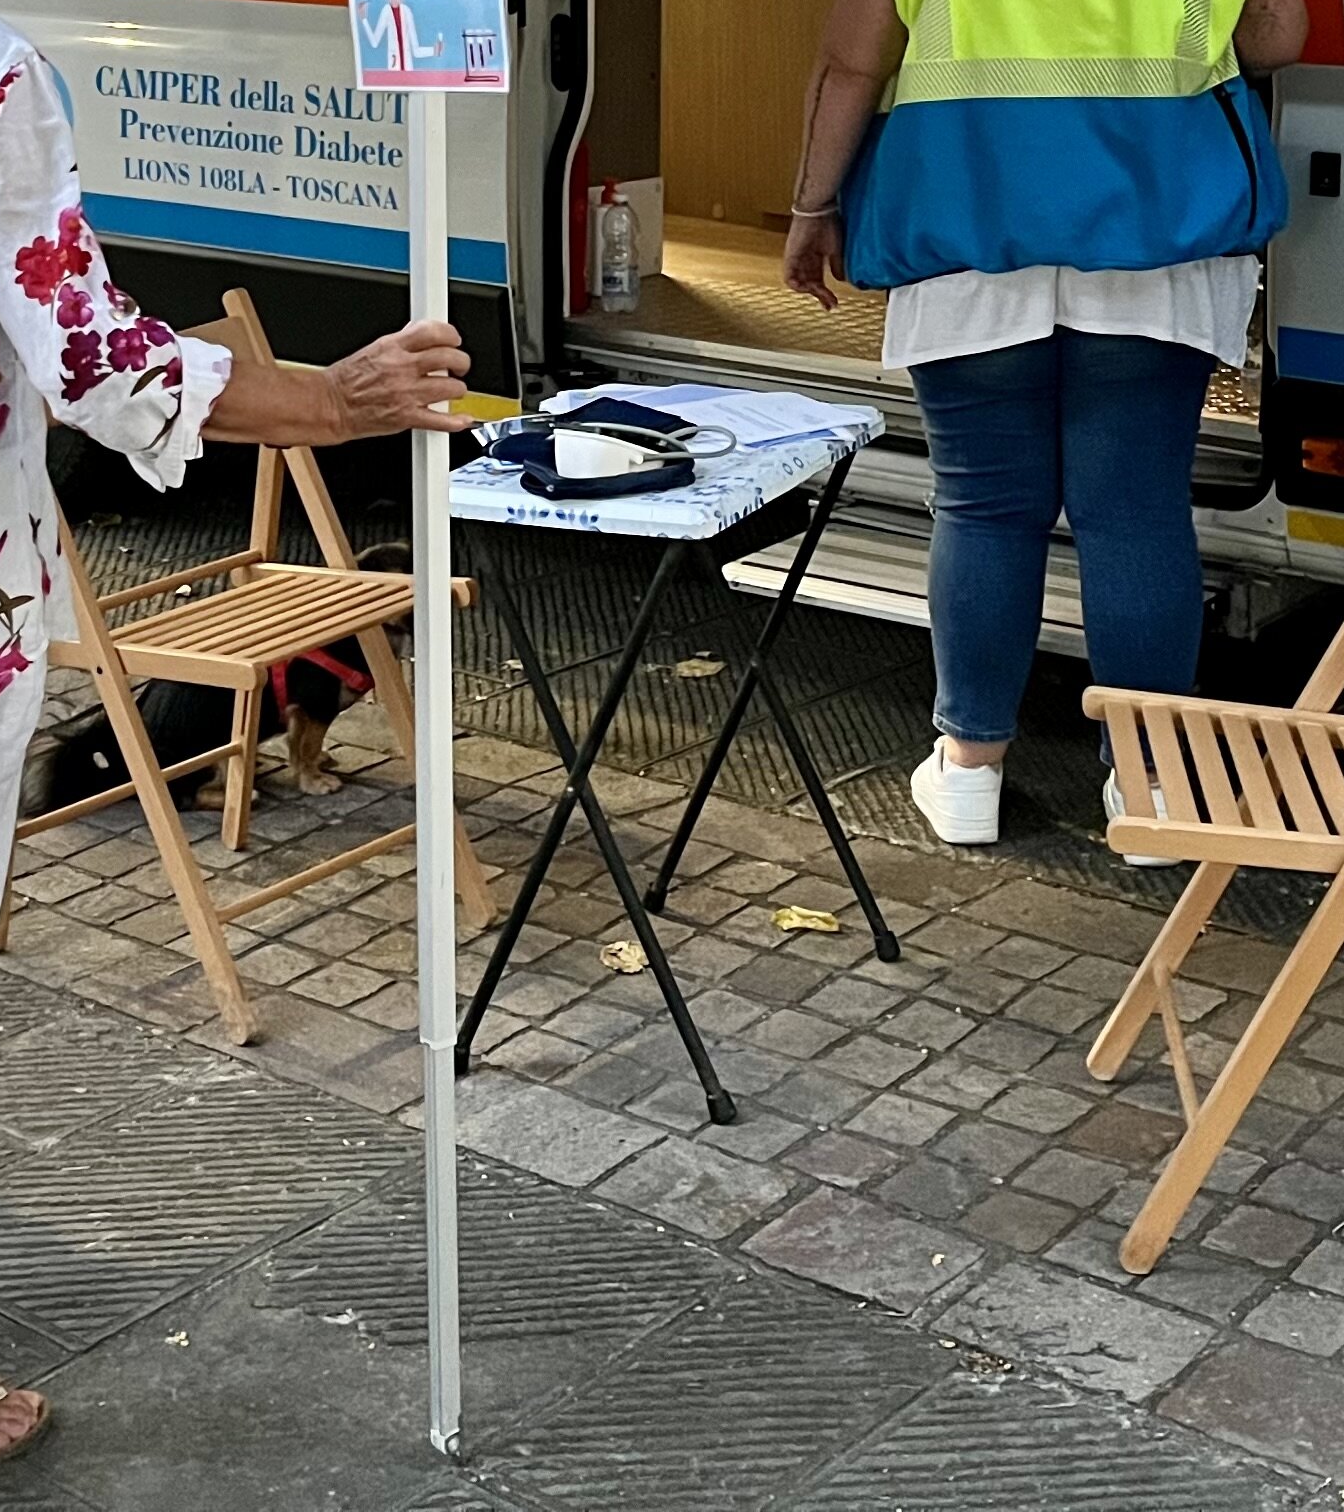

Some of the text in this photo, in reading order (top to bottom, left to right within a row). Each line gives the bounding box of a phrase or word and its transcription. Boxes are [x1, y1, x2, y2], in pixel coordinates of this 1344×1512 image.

[95, 65, 221, 107] CAMPER
[230, 78, 295, 115] della
[119, 108, 404, 168] Prevenzione Diabete
[124, 156, 191, 187] LIONS
[199, 165, 267, 195] 108LA
[286, 175, 399, 211] TOSCANA
